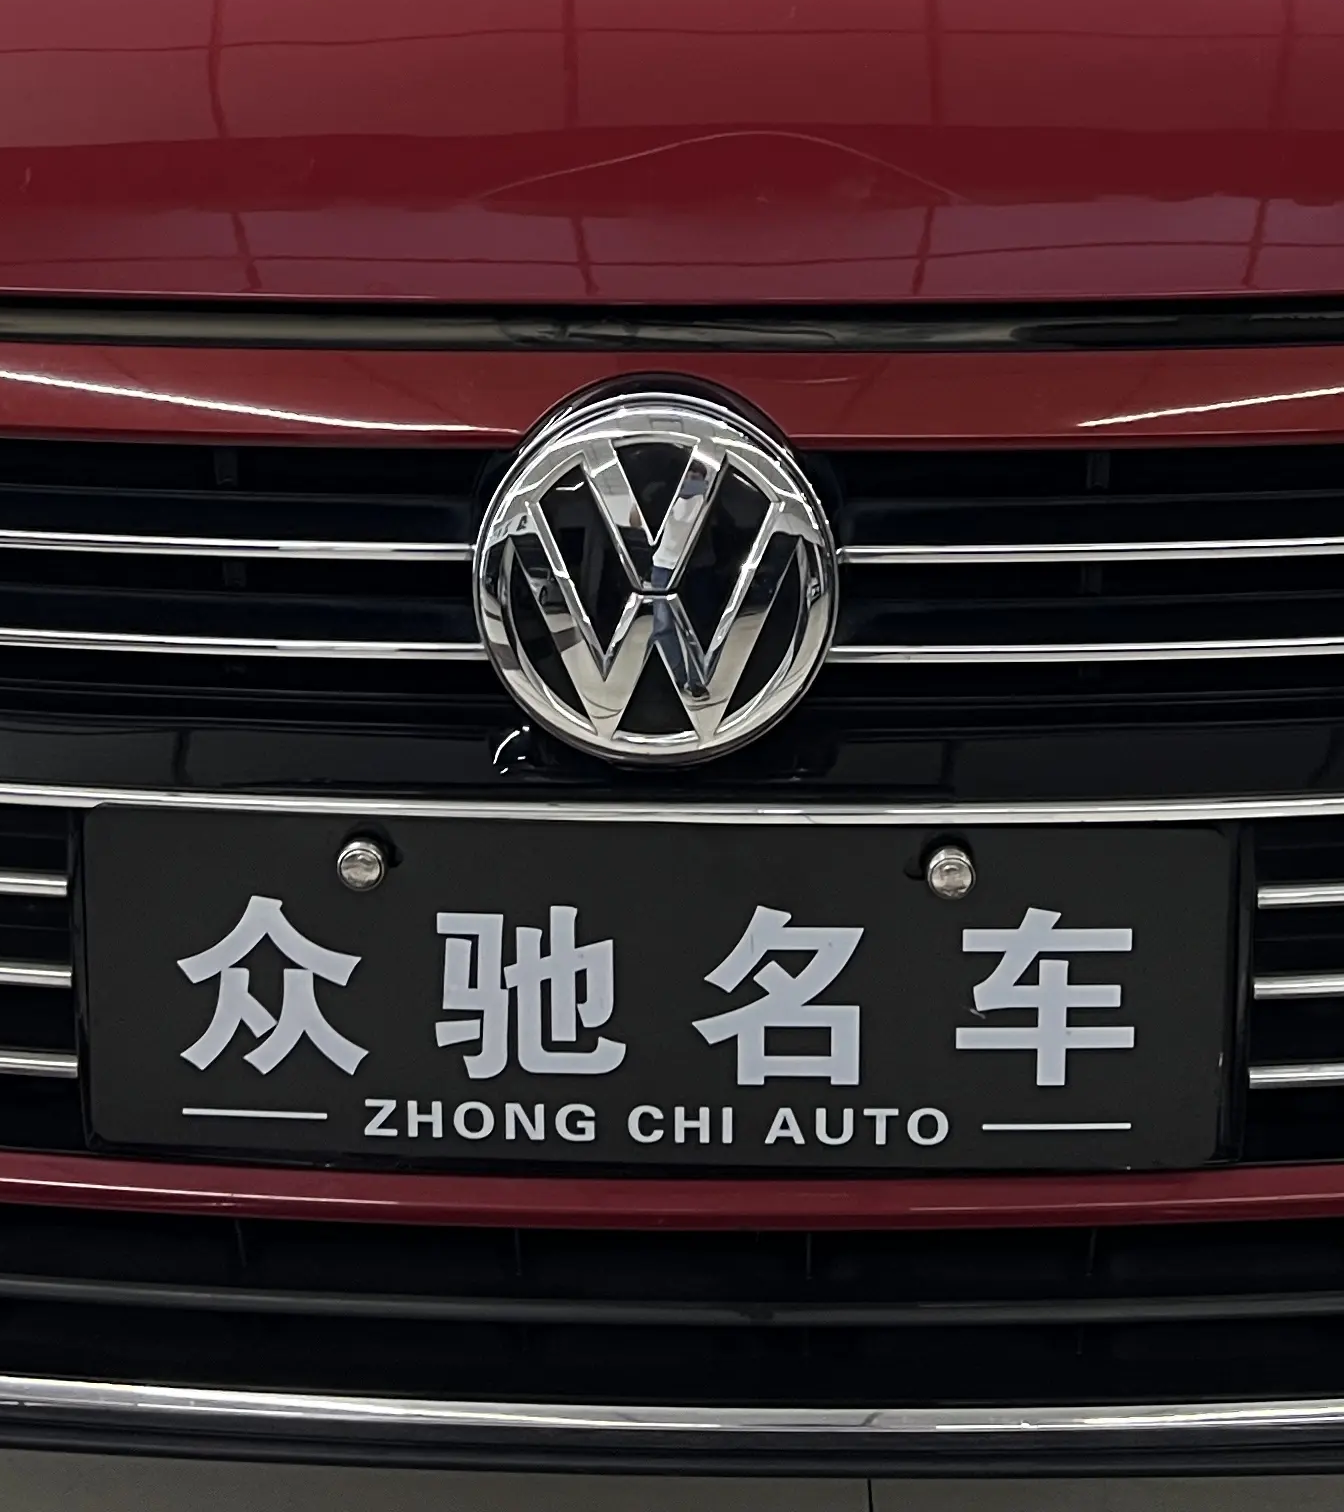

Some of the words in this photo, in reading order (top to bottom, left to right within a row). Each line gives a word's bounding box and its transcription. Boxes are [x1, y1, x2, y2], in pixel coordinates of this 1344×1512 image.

[176, 895, 1137, 1087] 众驰名车
[364, 1097, 598, 1144] ZHONG
[626, 1104, 735, 1146] CHI
[763, 1106, 951, 1148] AUTO
